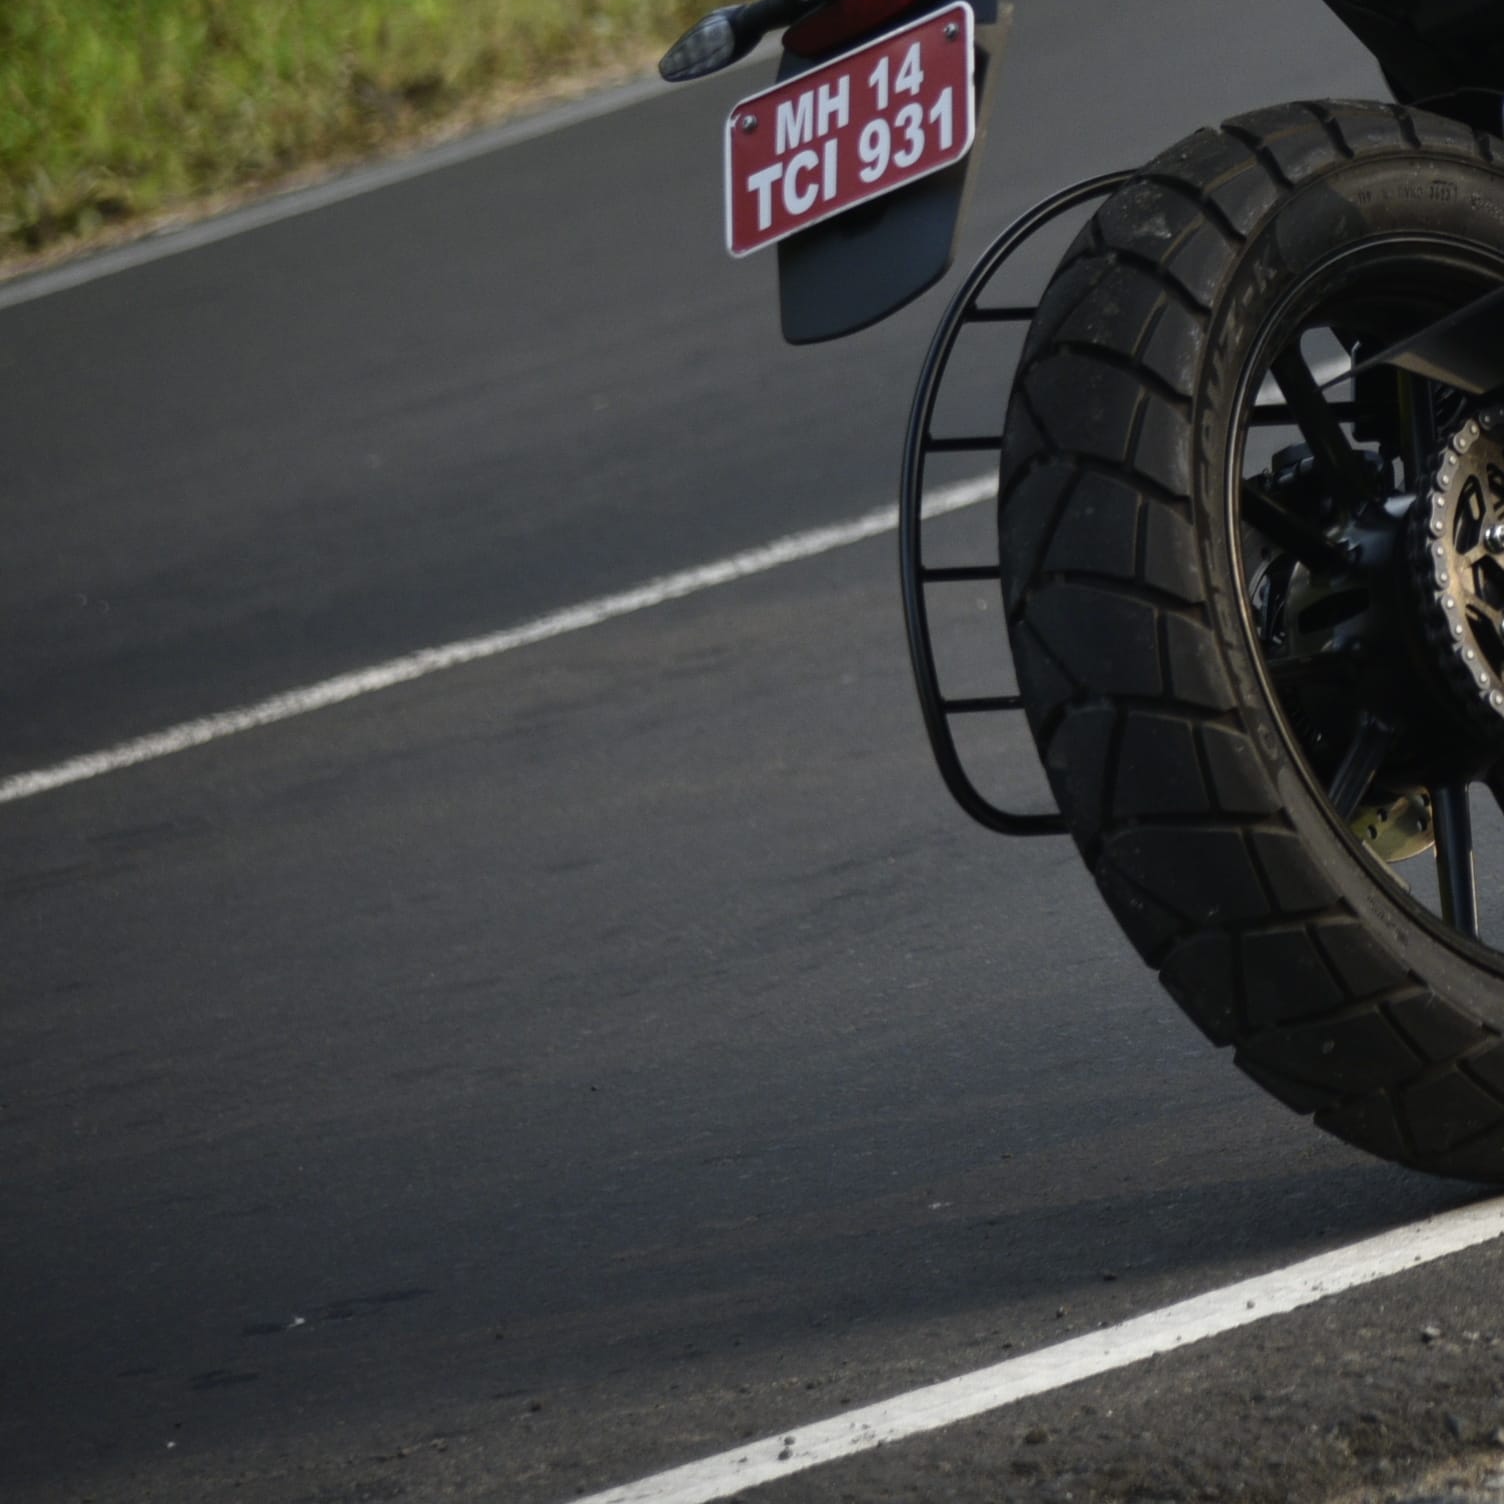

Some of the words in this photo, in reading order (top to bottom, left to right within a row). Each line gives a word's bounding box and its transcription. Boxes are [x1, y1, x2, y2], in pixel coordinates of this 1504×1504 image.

[747, 138, 838, 231] TCI
[858, 86, 953, 184] 931
[775, 75, 850, 156] MH
[868, 42, 924, 110] 14
